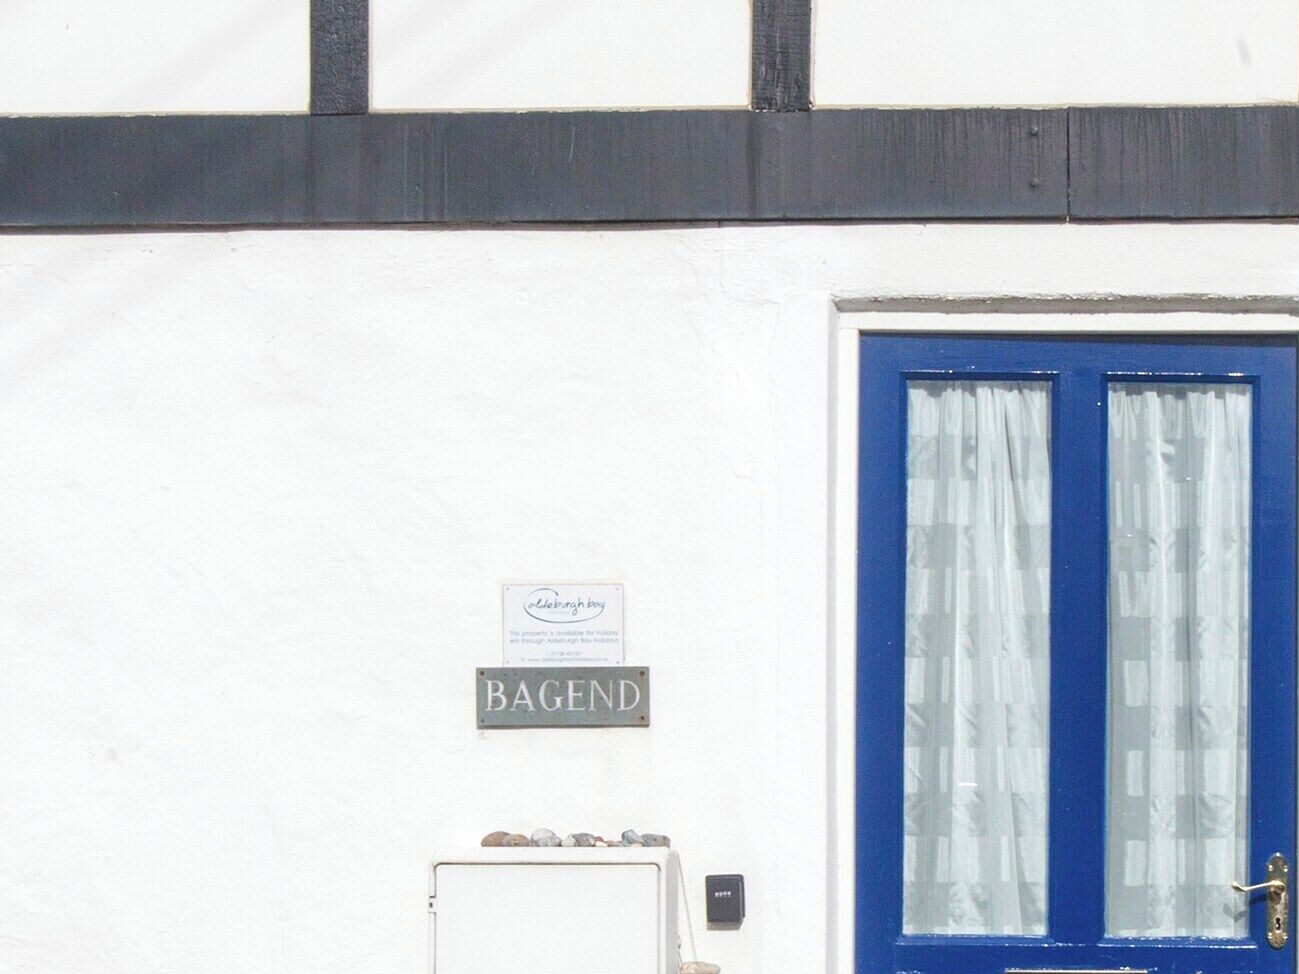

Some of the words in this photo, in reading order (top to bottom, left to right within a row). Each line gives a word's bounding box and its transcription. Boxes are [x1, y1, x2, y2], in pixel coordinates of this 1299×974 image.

[528, 598, 585, 616] aldeburgh
[586, 597, 606, 609] bay
[596, 630, 619, 638] holiday
[484, 679, 641, 712] BAGEND
